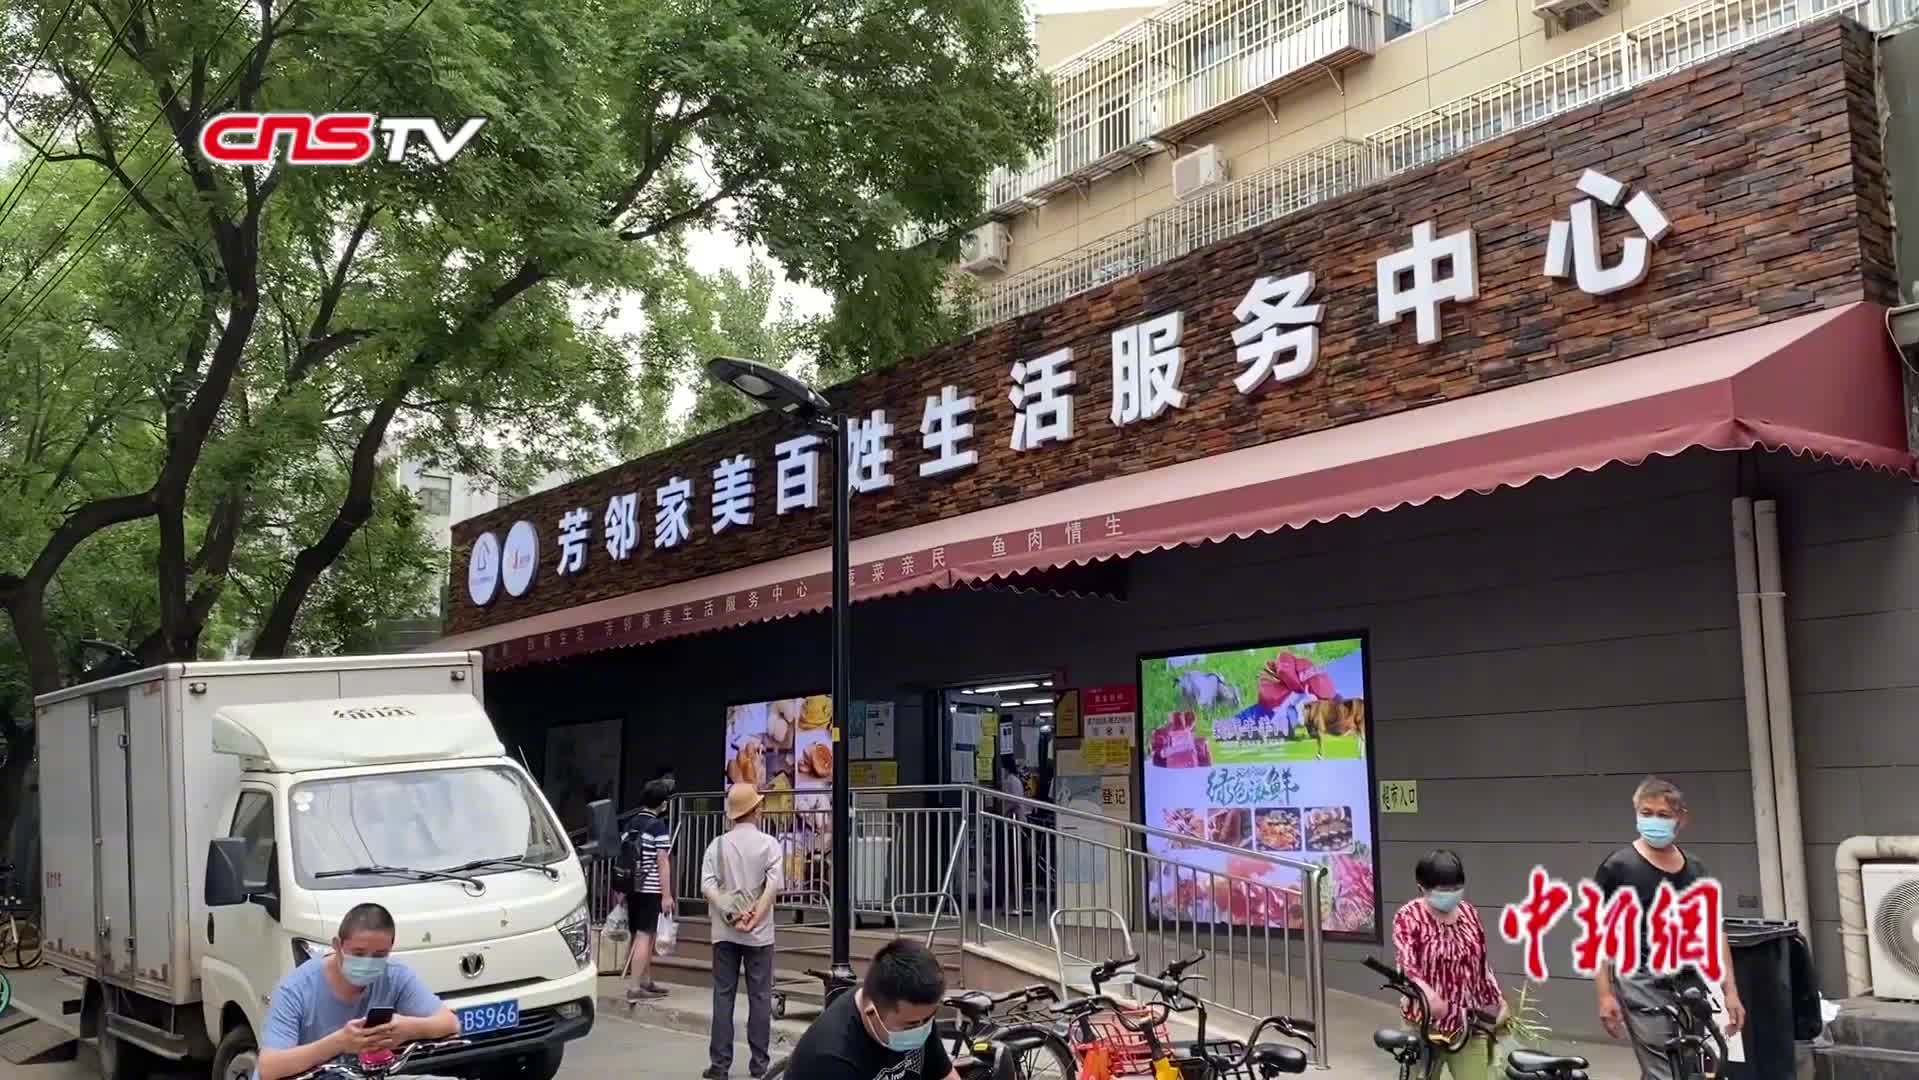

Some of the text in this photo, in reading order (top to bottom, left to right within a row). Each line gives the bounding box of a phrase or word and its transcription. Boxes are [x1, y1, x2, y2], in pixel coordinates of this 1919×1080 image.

[556, 168, 1673, 577] 芳邻家美百姓生活服务中心
[1103, 788, 1126, 805] 登记
